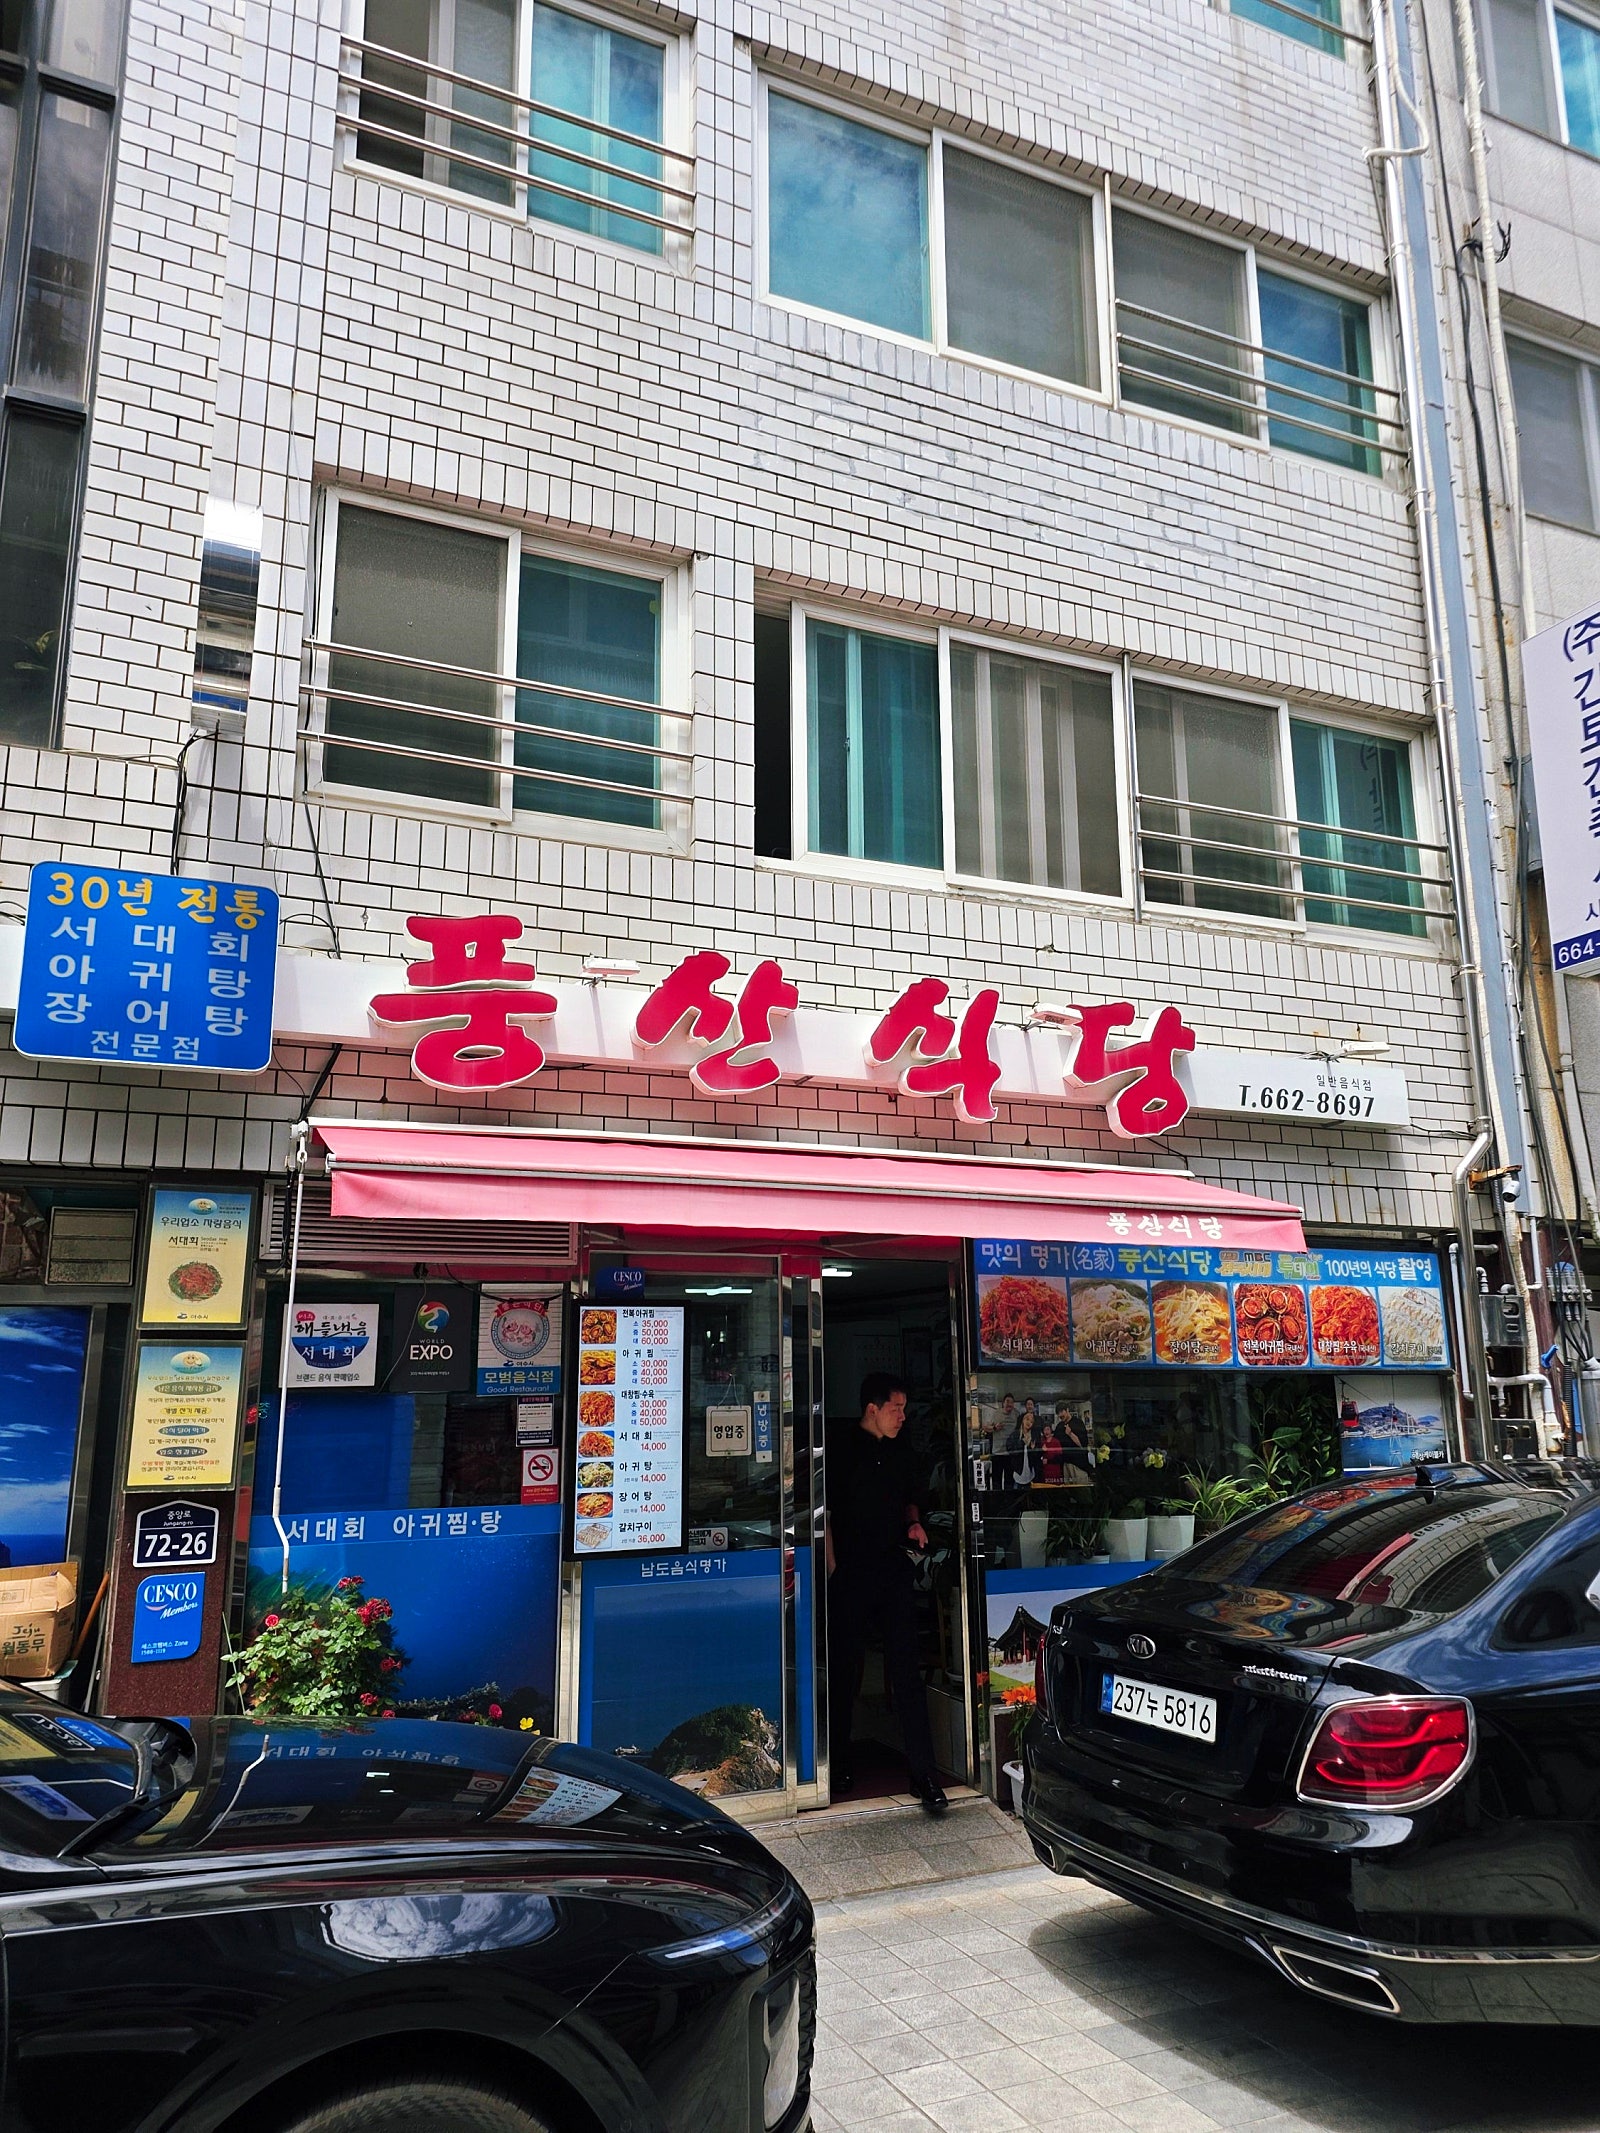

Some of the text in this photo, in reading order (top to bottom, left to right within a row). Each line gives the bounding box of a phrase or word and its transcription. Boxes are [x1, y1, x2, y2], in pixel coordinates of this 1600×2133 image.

[47, 872, 265, 930] 30년 전통
[1316, 1074, 1372, 1092] 일반음식점
[1239, 1085, 1375, 1118] T.662-8697
[160, 1216, 200, 1228] 우리업소
[1106, 1212, 1223, 1240] 풍산식당
[168, 1236, 199, 1246] 서대회
[981, 1243, 1022, 1269] 맛의
[1118, 1248, 1212, 1275] 풍산식당
[1244, 1252, 1271, 1262] MBC
[1325, 1257, 1432, 1282] 100년의 식당 촬영
[613, 1271, 642, 1282] CESCO
[641, 1320, 668, 1328] 35,000
[641, 1329, 669, 1337] 50,000
[641, 1337, 668, 1345] 60,000
[1001, 1338, 1034, 1352] 서대회
[1085, 1340, 1117, 1353] 아귀탕
[1170, 1341, 1201, 1354] 장어탕
[1243, 1340, 1284, 1353] 전복아귀찜
[409, 1344, 453, 1360] EXPO
[640, 1360, 667, 1368] 30,000
[483, 1371, 554, 1384] 모범음식점
[640, 1368, 667, 1377] 40,000
[640, 1377, 667, 1385] 50,000
[510, 1385, 550, 1393] Restaurant
[640, 1400, 667, 1409] 30,000
[640, 1409, 667, 1417] 40,000
[640, 1417, 667, 1426] 50,000
[713, 1425, 745, 1439] 영업중
[641, 1442, 667, 1452] 14,000
[640, 1474, 667, 1483] 14,000
[167, 1510, 192, 1520] 중앙로
[640, 1504, 666, 1513] 14,000
[618, 1522, 652, 1533] 갈치구이
[144, 1532, 207, 1558] 72-26
[637, 1534, 665, 1543] 36,000
[641, 1558, 727, 1578] 남도음식명가
[143, 1582, 197, 1604] CESCO
[159, 1601, 199, 1620] Members
[13, 1623, 41, 1638] Jeju
[2, 1638, 46, 1656] 월동무
[1129, 1637, 1149, 1655] KIA
[1113, 1682, 1211, 1734] 237누 5816
